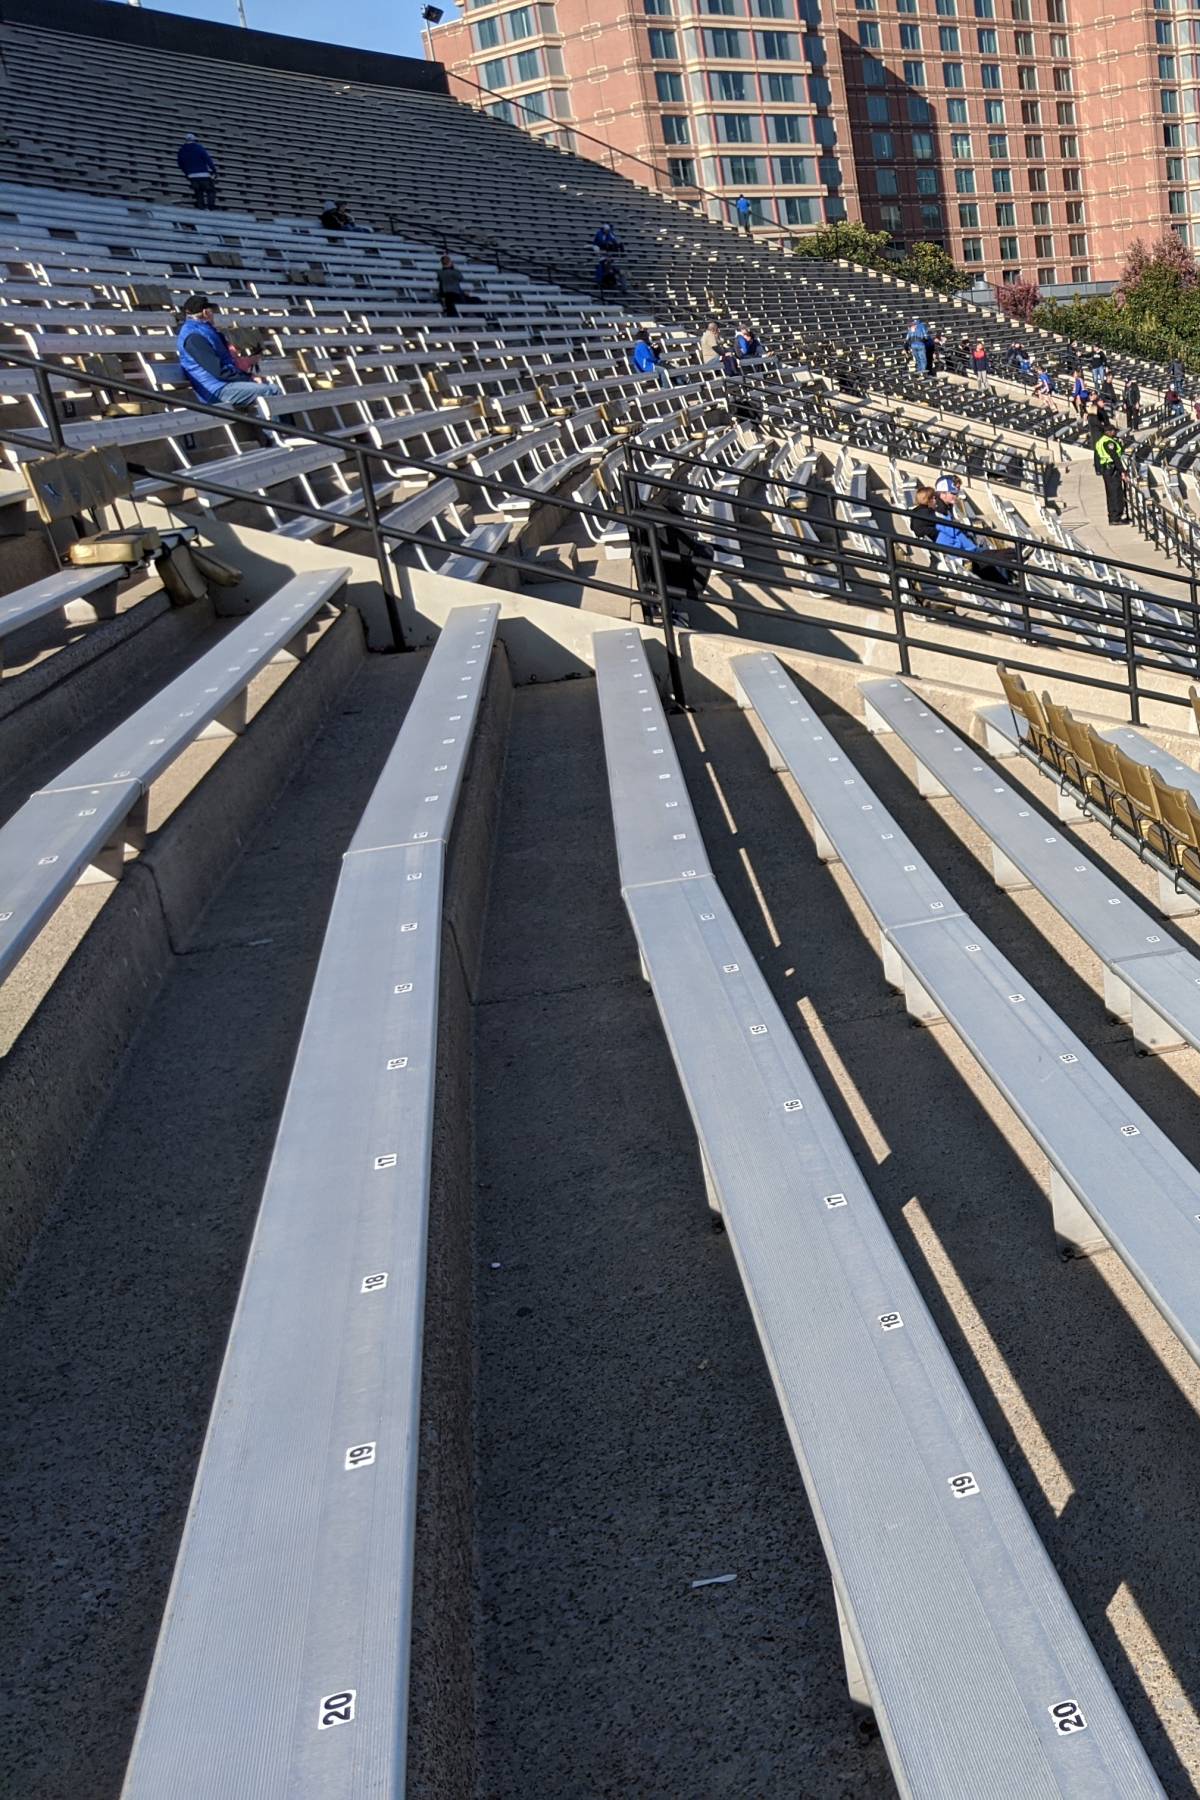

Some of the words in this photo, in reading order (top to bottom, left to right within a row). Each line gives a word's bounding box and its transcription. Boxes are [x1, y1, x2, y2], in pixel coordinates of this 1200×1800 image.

[389, 1058, 405, 1068] 16
[1061, 1054, 1076, 1063] 15
[787, 1100, 803, 1110] 16
[1122, 1127, 1138, 1136] 16
[377, 1155, 394, 1167] 17
[826, 1194, 844, 1207] 17
[363, 1274, 385, 1291] 18
[880, 1312, 900, 1329] 18
[347, 1444, 373, 1467] 19
[950, 1474, 977, 1496] 19
[323, 1693, 352, 1726] 20
[1051, 1703, 1084, 1733] 20
